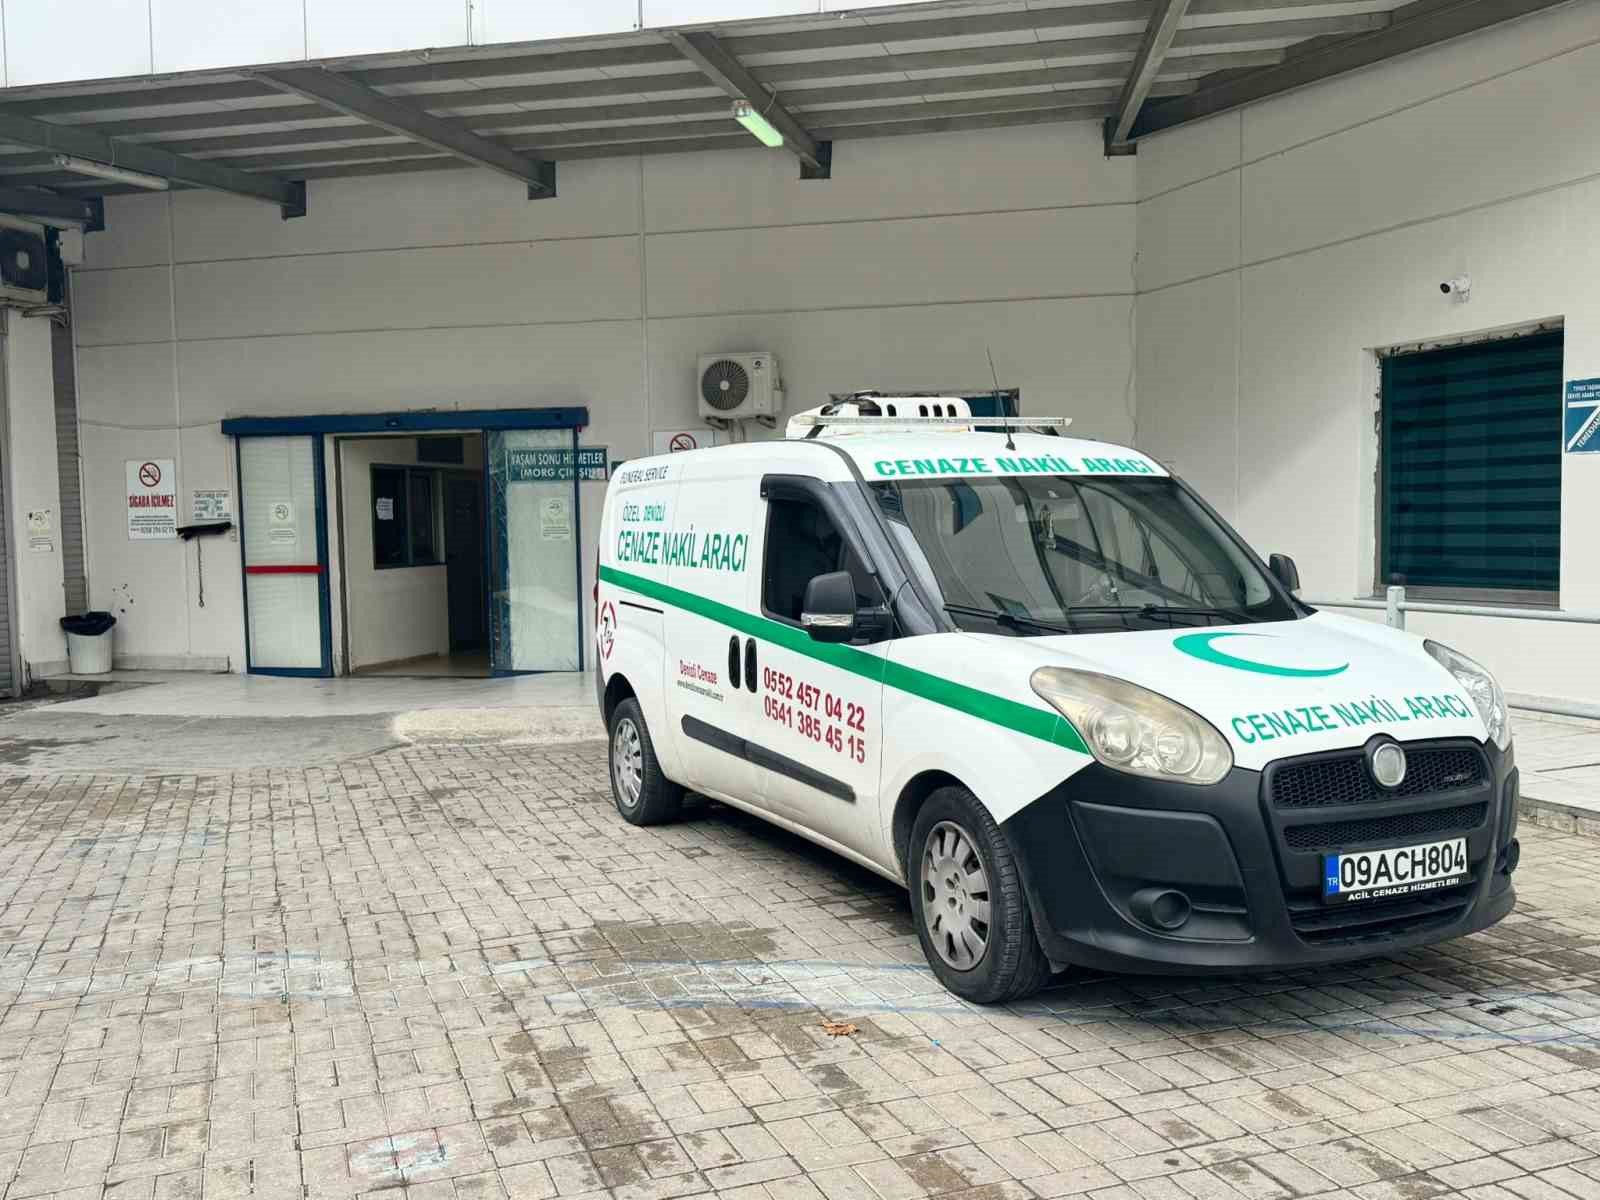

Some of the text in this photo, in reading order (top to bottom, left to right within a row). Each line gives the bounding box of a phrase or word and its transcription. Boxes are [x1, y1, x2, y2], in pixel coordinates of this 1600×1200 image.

[511, 453, 537, 466] YAŞAM
[538, 452, 561, 465] SONU
[874, 453, 1156, 477] CENAZE NAKİL ARACI
[644, 465, 669, 482] SERVICE
[623, 501, 641, 522] ÖZEL
[617, 523, 749, 572] CENAZE NAKİL ARACI
[697, 664, 718, 685] Cenaze
[764, 667, 865, 733] 0552 457 04 22
[1231, 693, 1474, 744] CENAZE NAKİL ARACI
[764, 695, 865, 764] 0541 385 45 15
[1327, 877, 1339, 887] TR
[1348, 889, 1371, 901] ACİL
[1372, 886, 1409, 898] CENAZE
